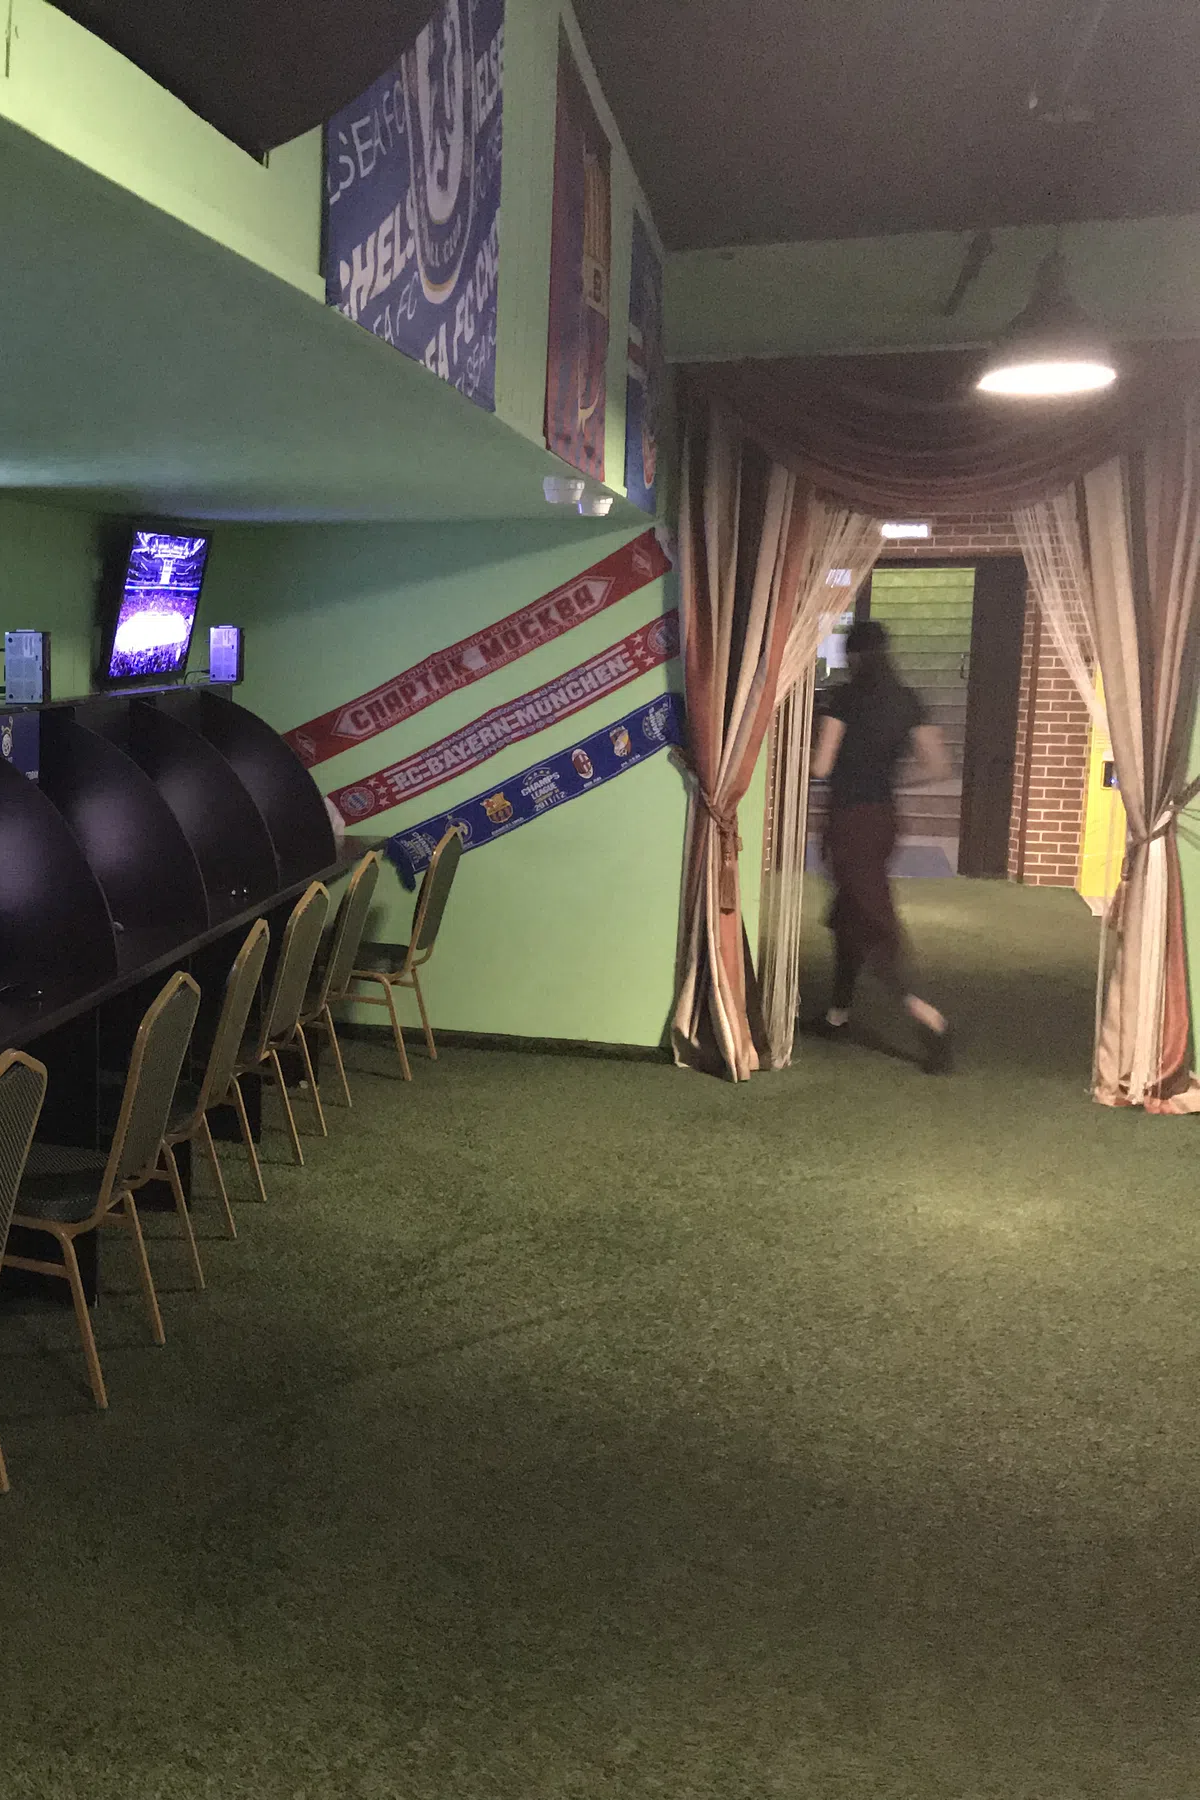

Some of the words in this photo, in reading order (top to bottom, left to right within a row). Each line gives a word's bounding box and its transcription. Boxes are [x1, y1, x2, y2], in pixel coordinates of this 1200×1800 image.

[350, 652, 472, 731] СПАРТАК
[478, 583, 597, 665] МОСКВА
[424, 716, 513, 776] BAYERN
[520, 771, 560, 797] CHAMPS
[530, 781, 557, 800] LEAGUE
[534, 791, 567, 812] 2011/12
